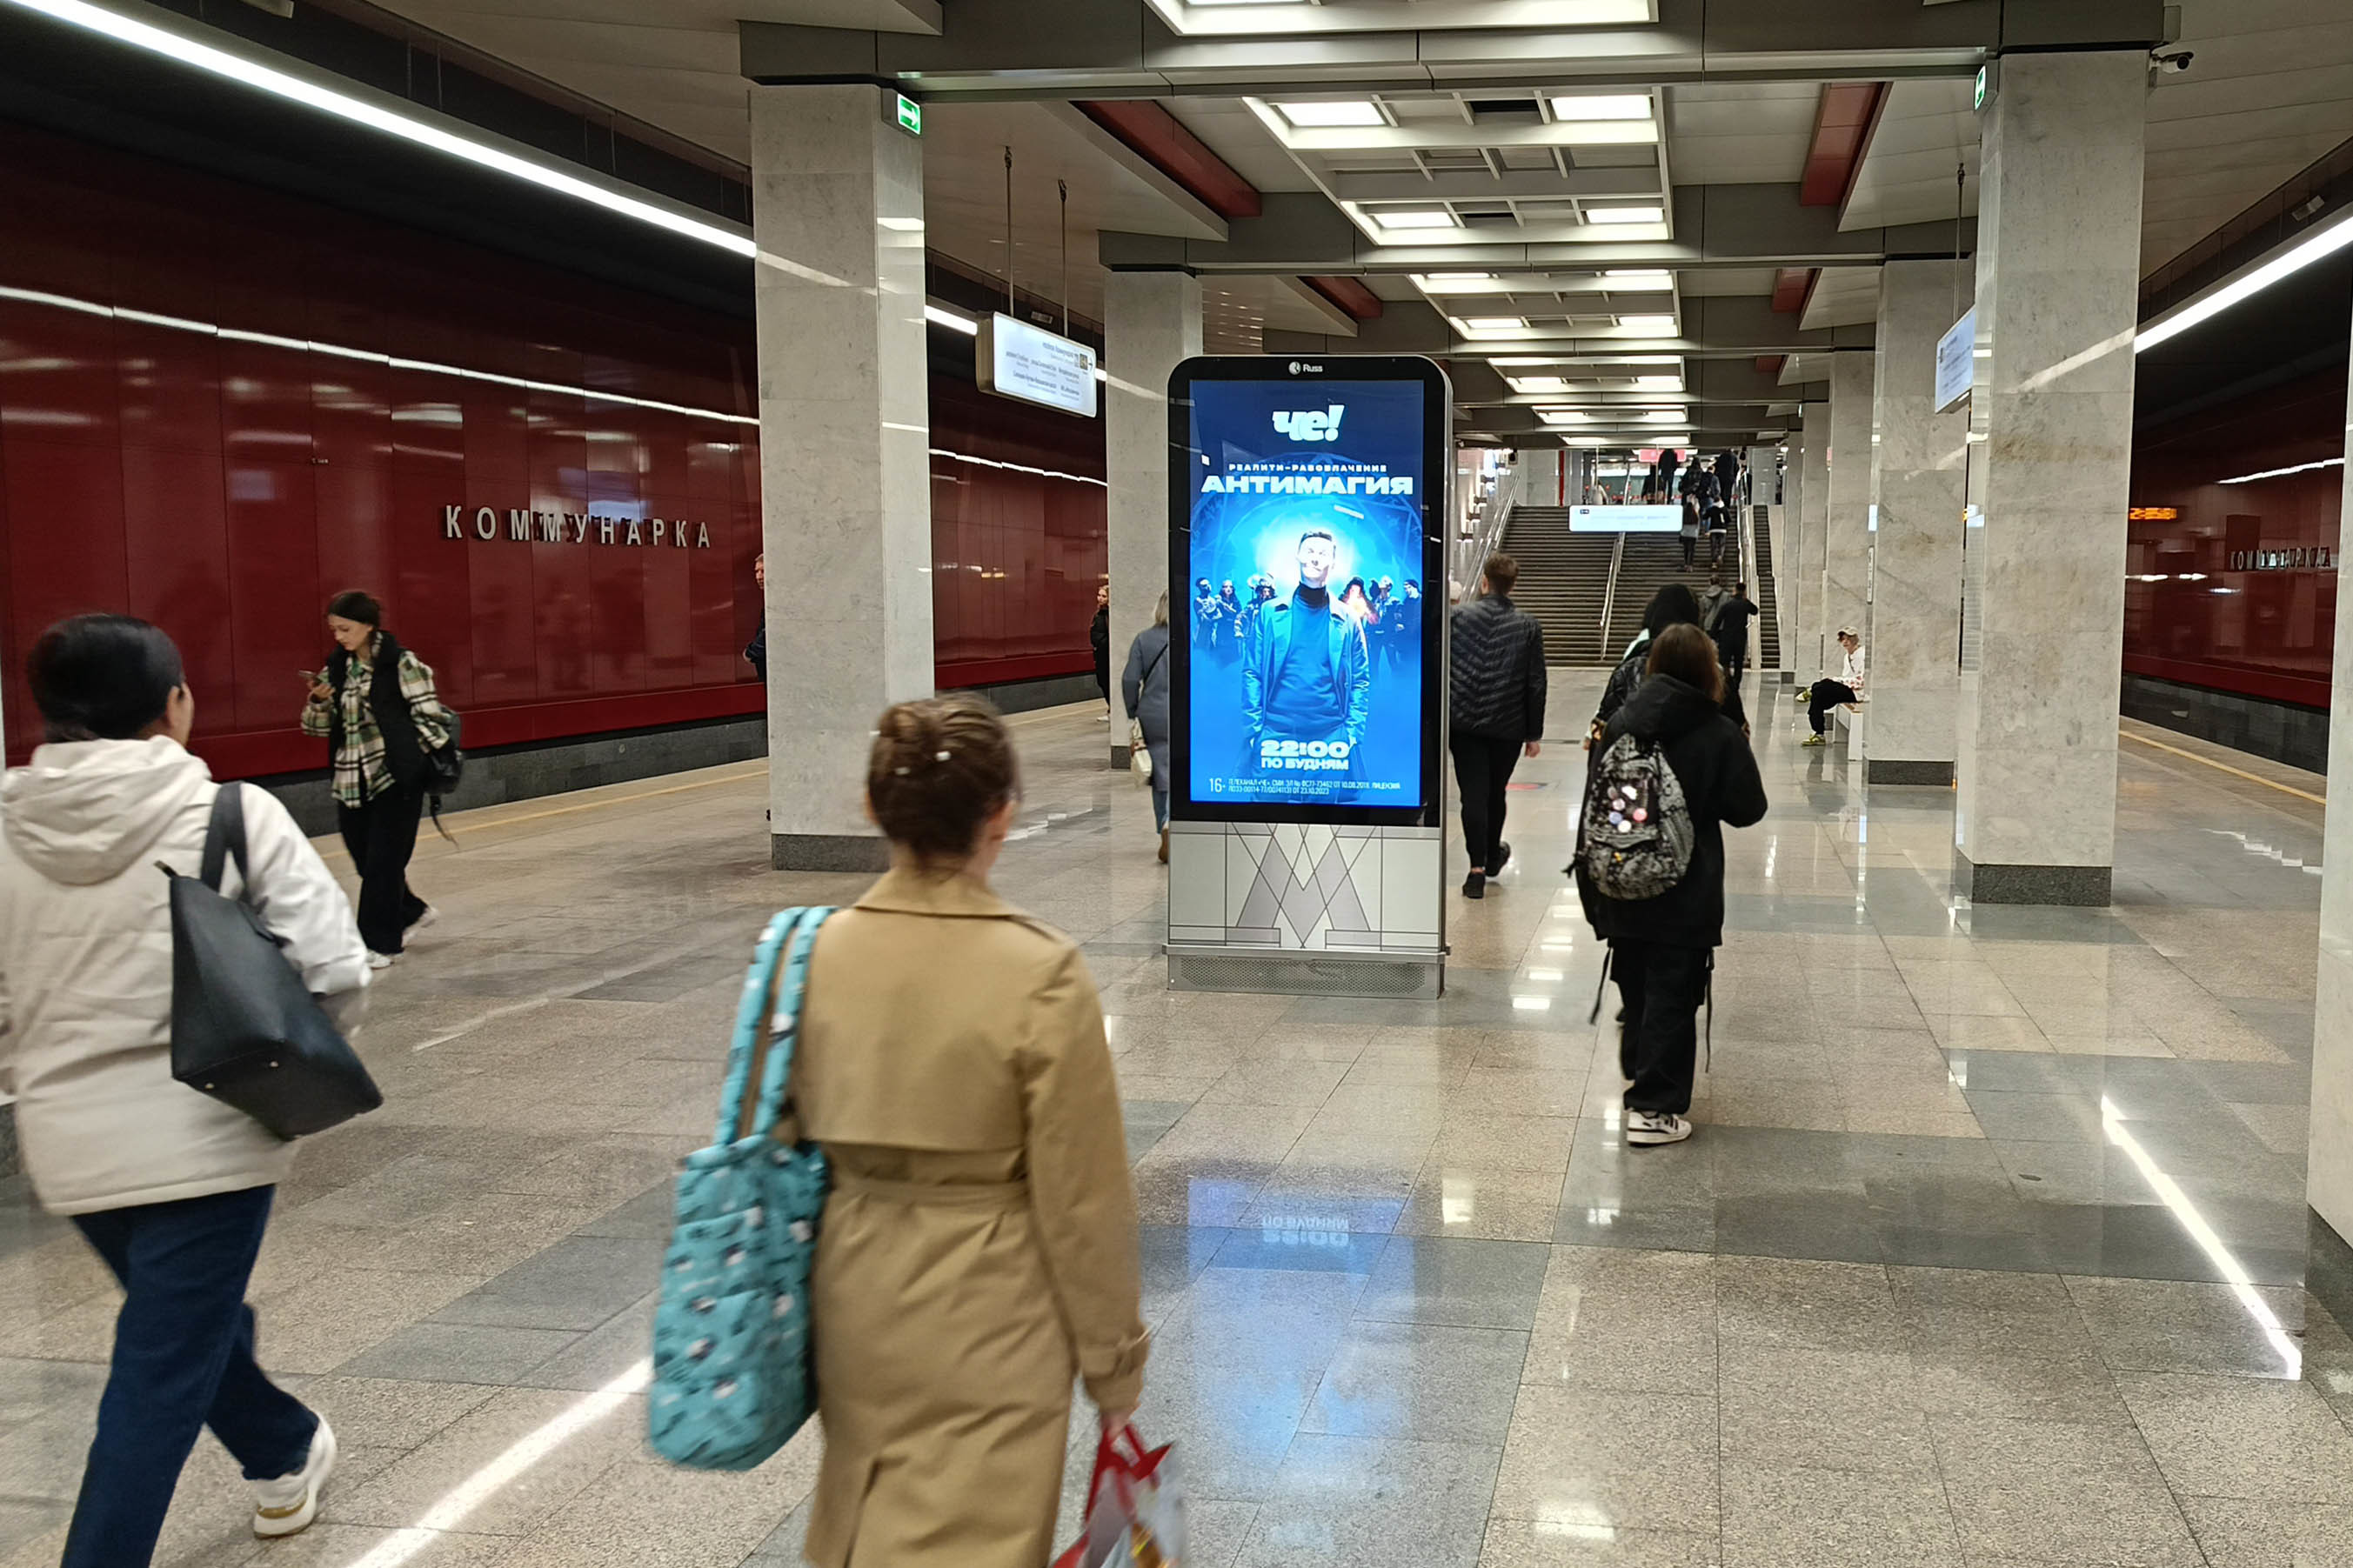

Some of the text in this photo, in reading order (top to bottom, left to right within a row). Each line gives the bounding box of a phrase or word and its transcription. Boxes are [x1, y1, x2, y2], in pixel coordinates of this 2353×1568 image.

[1302, 364, 1323, 373] Russ
[1228, 464, 1387, 473] РЕАЛИТИ-РАЗОБЛАЧЕНИЕ
[1200, 475, 1414, 495] АНТИМАГИЯ
[445, 504, 711, 549] КОММУНАРКА
[1260, 739, 1350, 759] 22:00
[1261, 757, 1349, 771] ПО БУДНЯМ
